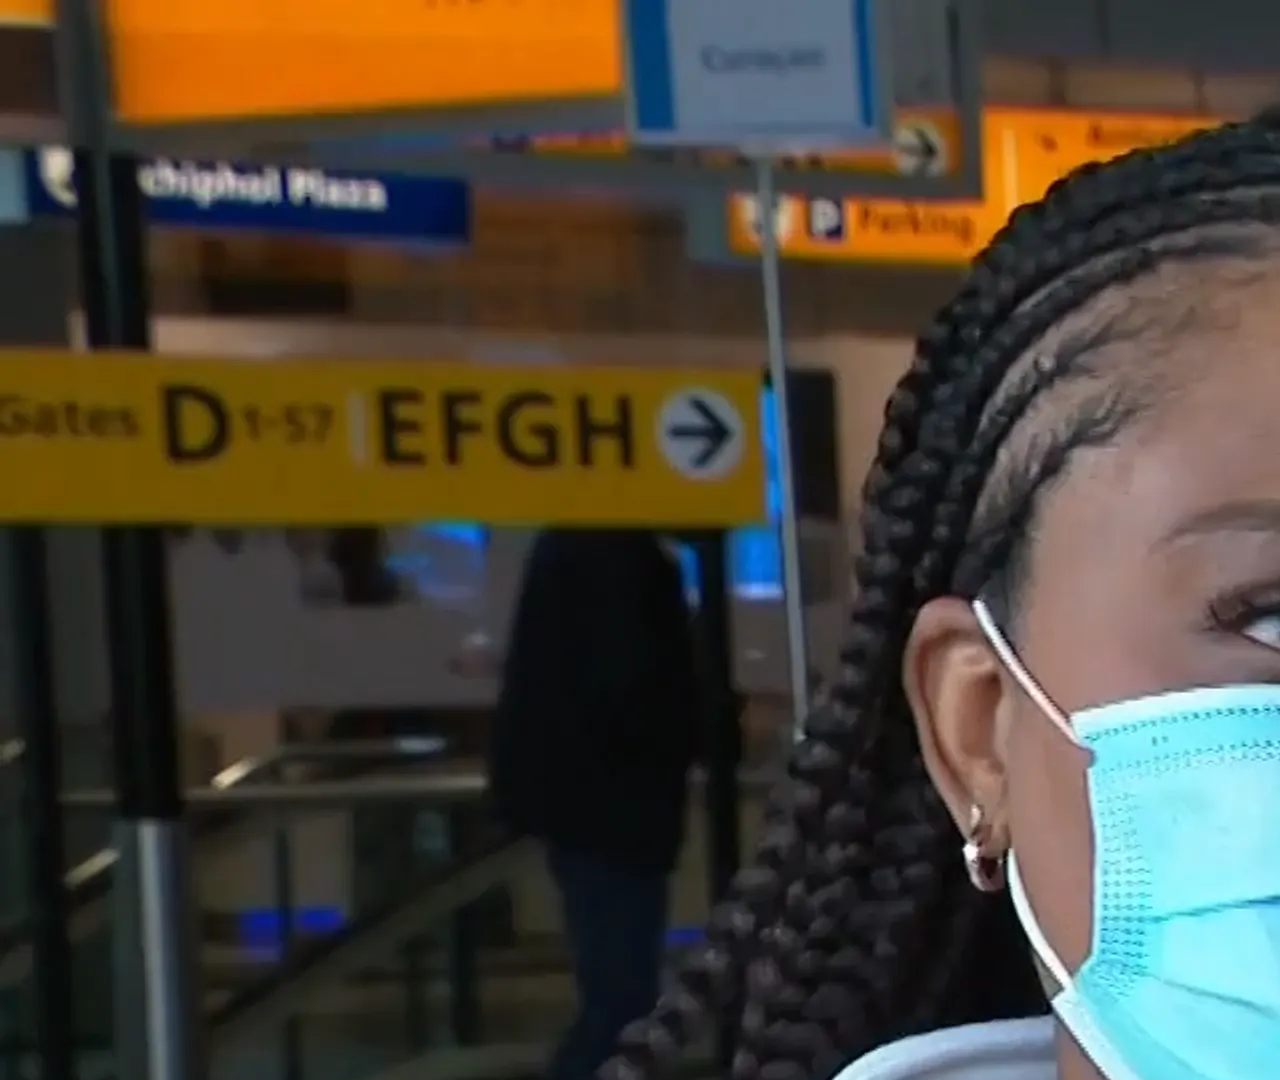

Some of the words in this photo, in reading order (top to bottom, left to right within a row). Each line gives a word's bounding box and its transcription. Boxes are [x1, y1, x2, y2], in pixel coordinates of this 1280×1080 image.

[137, 157, 284, 208] chiphol
[288, 167, 388, 212] Plaza
[858, 203, 976, 248] Parking
[162, 385, 229, 464] D
[378, 387, 633, 469] EFGH
